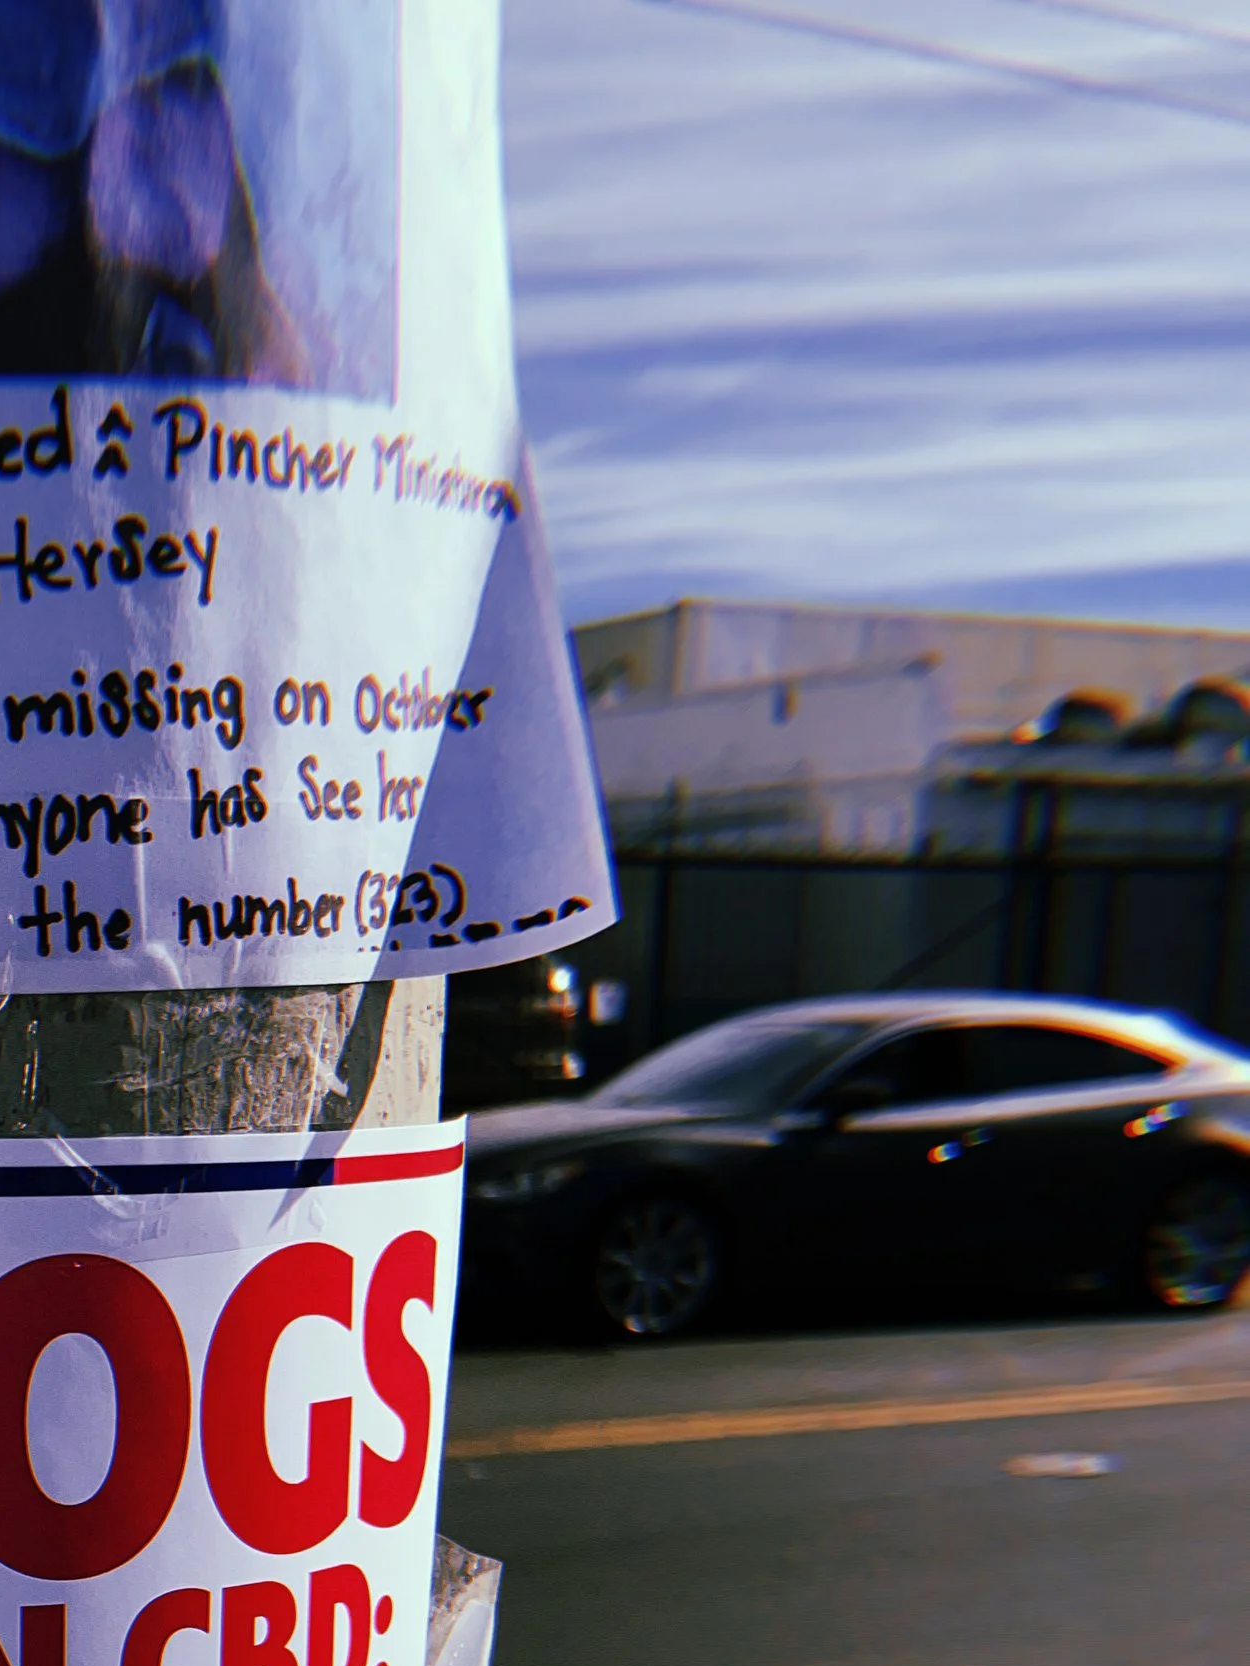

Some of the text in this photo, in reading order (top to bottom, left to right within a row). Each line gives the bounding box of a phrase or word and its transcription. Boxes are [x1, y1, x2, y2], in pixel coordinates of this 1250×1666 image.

[152, 396, 356, 492] Pincher
[4, 661, 245, 750] missing
[275, 676, 331, 726] on
[354, 665, 494, 734] October
[187, 766, 268, 839] has
[376, 748, 423, 823] her
[18, 879, 132, 957] the
[178, 877, 345, 946] number
